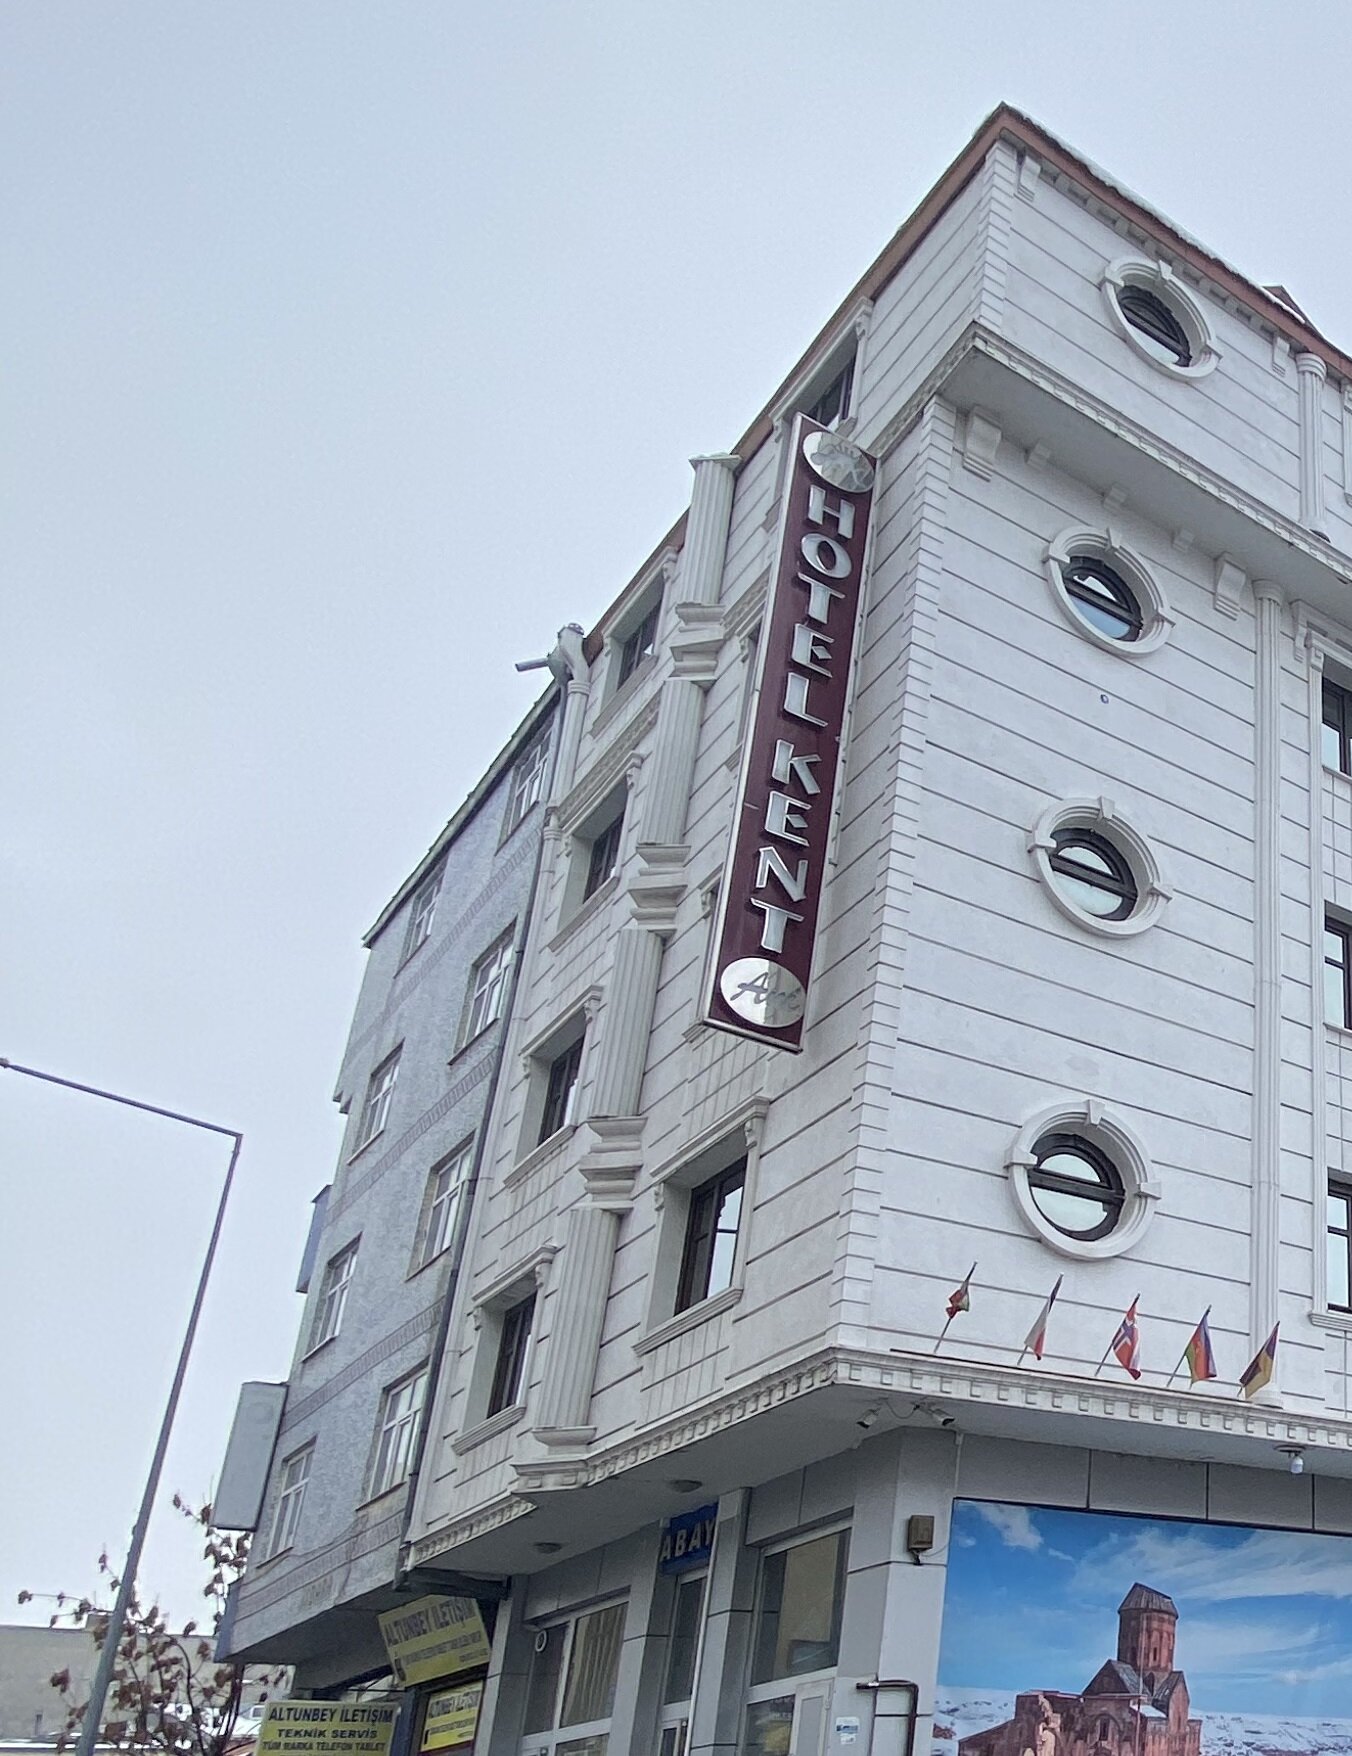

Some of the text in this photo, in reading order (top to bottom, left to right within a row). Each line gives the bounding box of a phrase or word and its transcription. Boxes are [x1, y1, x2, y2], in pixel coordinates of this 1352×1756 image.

[751, 486, 856, 954] HOTEL KENT
[660, 1519, 715, 1562] ABAY
[268, 1705, 394, 1726] ALTUNBEY İLETİŞİM
[277, 1727, 378, 1739] TEKNİK SERVİS
